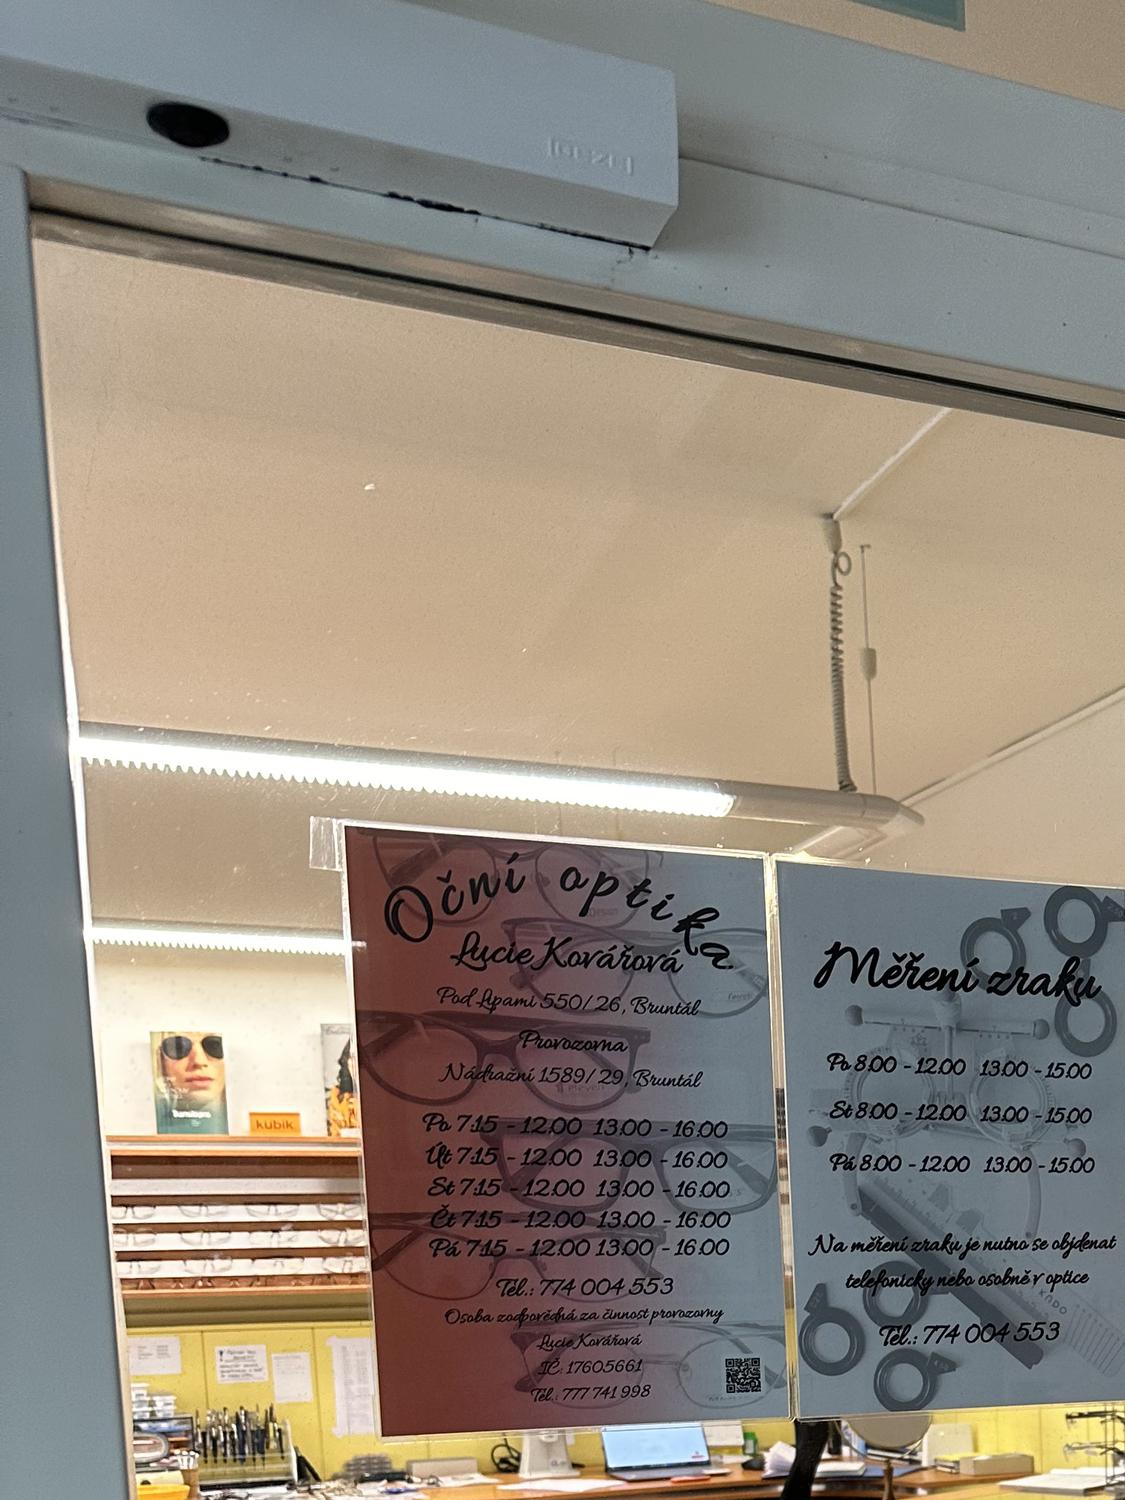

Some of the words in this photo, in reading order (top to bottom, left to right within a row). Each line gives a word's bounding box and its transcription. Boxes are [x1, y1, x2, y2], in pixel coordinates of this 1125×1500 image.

[384, 852, 526, 943] Oční
[559, 865, 735, 971] optika
[450, 930, 535, 973] Lucie
[530, 936, 685, 974] Kovářová
[813, 940, 981, 994] Měření
[985, 955, 1103, 1008] zraku
[436, 986, 474, 1009] Pod
[475, 987, 538, 1016] Lipami
[630, 996, 703, 1017] Bruntál
[519, 1029, 630, 1054] Provozovna
[827, 1053, 853, 1072] Po
[439, 1062, 536, 1084] Nádražní
[632, 1069, 705, 1090] Bruntál
[829, 1100, 854, 1121] St
[256, 1119, 294, 1130] kubik
[422, 1112, 452, 1134] Po
[425, 1142, 453, 1169] Út
[829, 1153, 858, 1173] Pá
[427, 1176, 456, 1197] St
[430, 1204, 456, 1229] Čt
[428, 1238, 460, 1259] Pá
[807, 1233, 849, 1256] Na
[851, 1235, 910, 1254] měření
[911, 1233, 963, 1255] zraku
[958, 1236, 981, 1261] je
[983, 1235, 1030, 1253] nutno
[1031, 1238, 1050, 1252] se
[540, 1277, 577, 1297] 774
[580, 1277, 625, 1296] 004
[627, 1277, 674, 1296] 553
[845, 1269, 935, 1297] telefonicky
[936, 1268, 976, 1288] nebo
[977, 1267, 1030, 1287] osobně
[1032, 1271, 1047, 1289] v
[1045, 1271, 1091, 1293] optice
[444, 1307, 493, 1325] Osoba
[496, 1307, 578, 1328] zodpovědná
[579, 1311, 600, 1322] za
[602, 1307, 650, 1321] činnost
[649, 1308, 725, 1326] provozovny
[536, 1333, 575, 1353] Lucie
[573, 1332, 643, 1349] Kovářová
[922, 1324, 961, 1346] 774
[964, 1323, 1011, 1344] 004
[1012, 1320, 1062, 1342] 553
[565, 1358, 643, 1376] 17605661
[561, 1387, 593, 1402] 777
[592, 1386, 618, 1401] 741
[619, 1384, 651, 1399] 998
